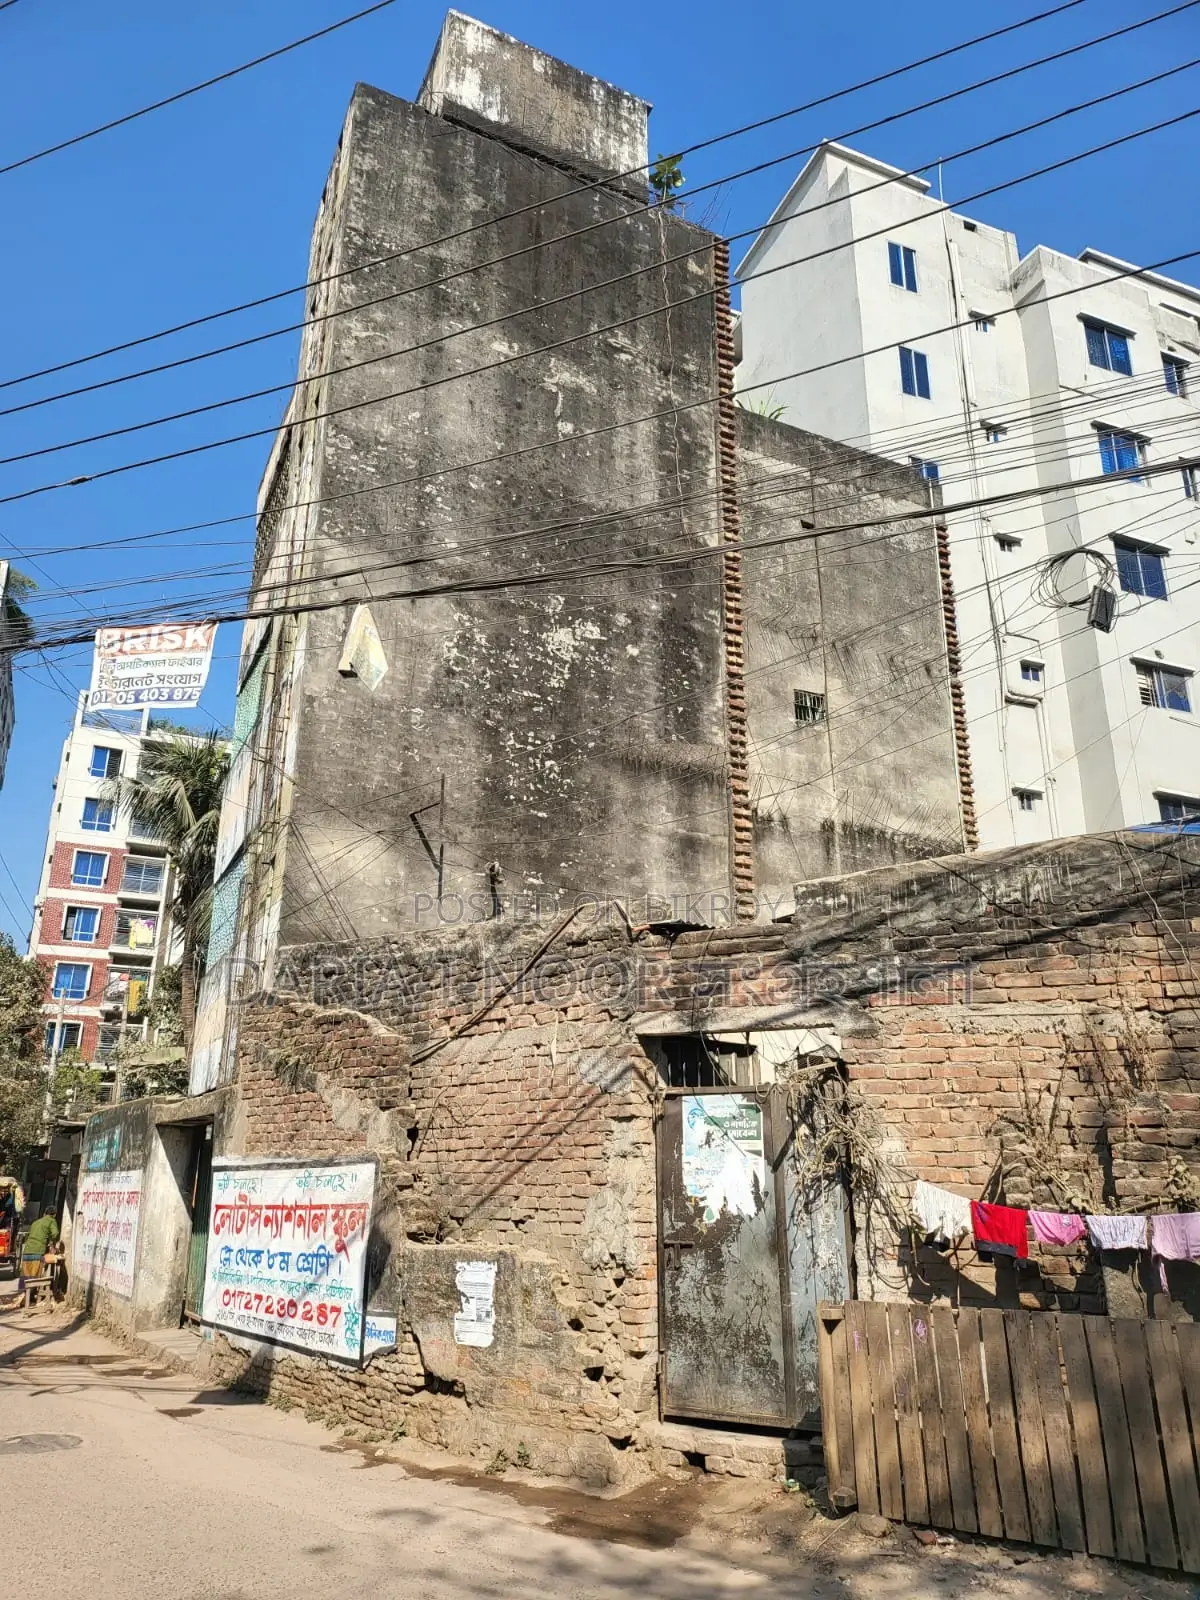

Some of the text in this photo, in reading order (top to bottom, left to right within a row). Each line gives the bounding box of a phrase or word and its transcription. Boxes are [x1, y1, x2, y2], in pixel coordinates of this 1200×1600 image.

[101, 624, 208, 654] BRISK
[168, 657, 203, 668] ফাইবার
[155, 672, 202, 686] সংযোগ
[139, 688, 170, 702] 403
[173, 687, 201, 701] 875
[263, 1196, 329, 1240] ন্যাশনাল
[330, 1202, 370, 1263] স্কুল
[235, 1245, 264, 1268] থেকে
